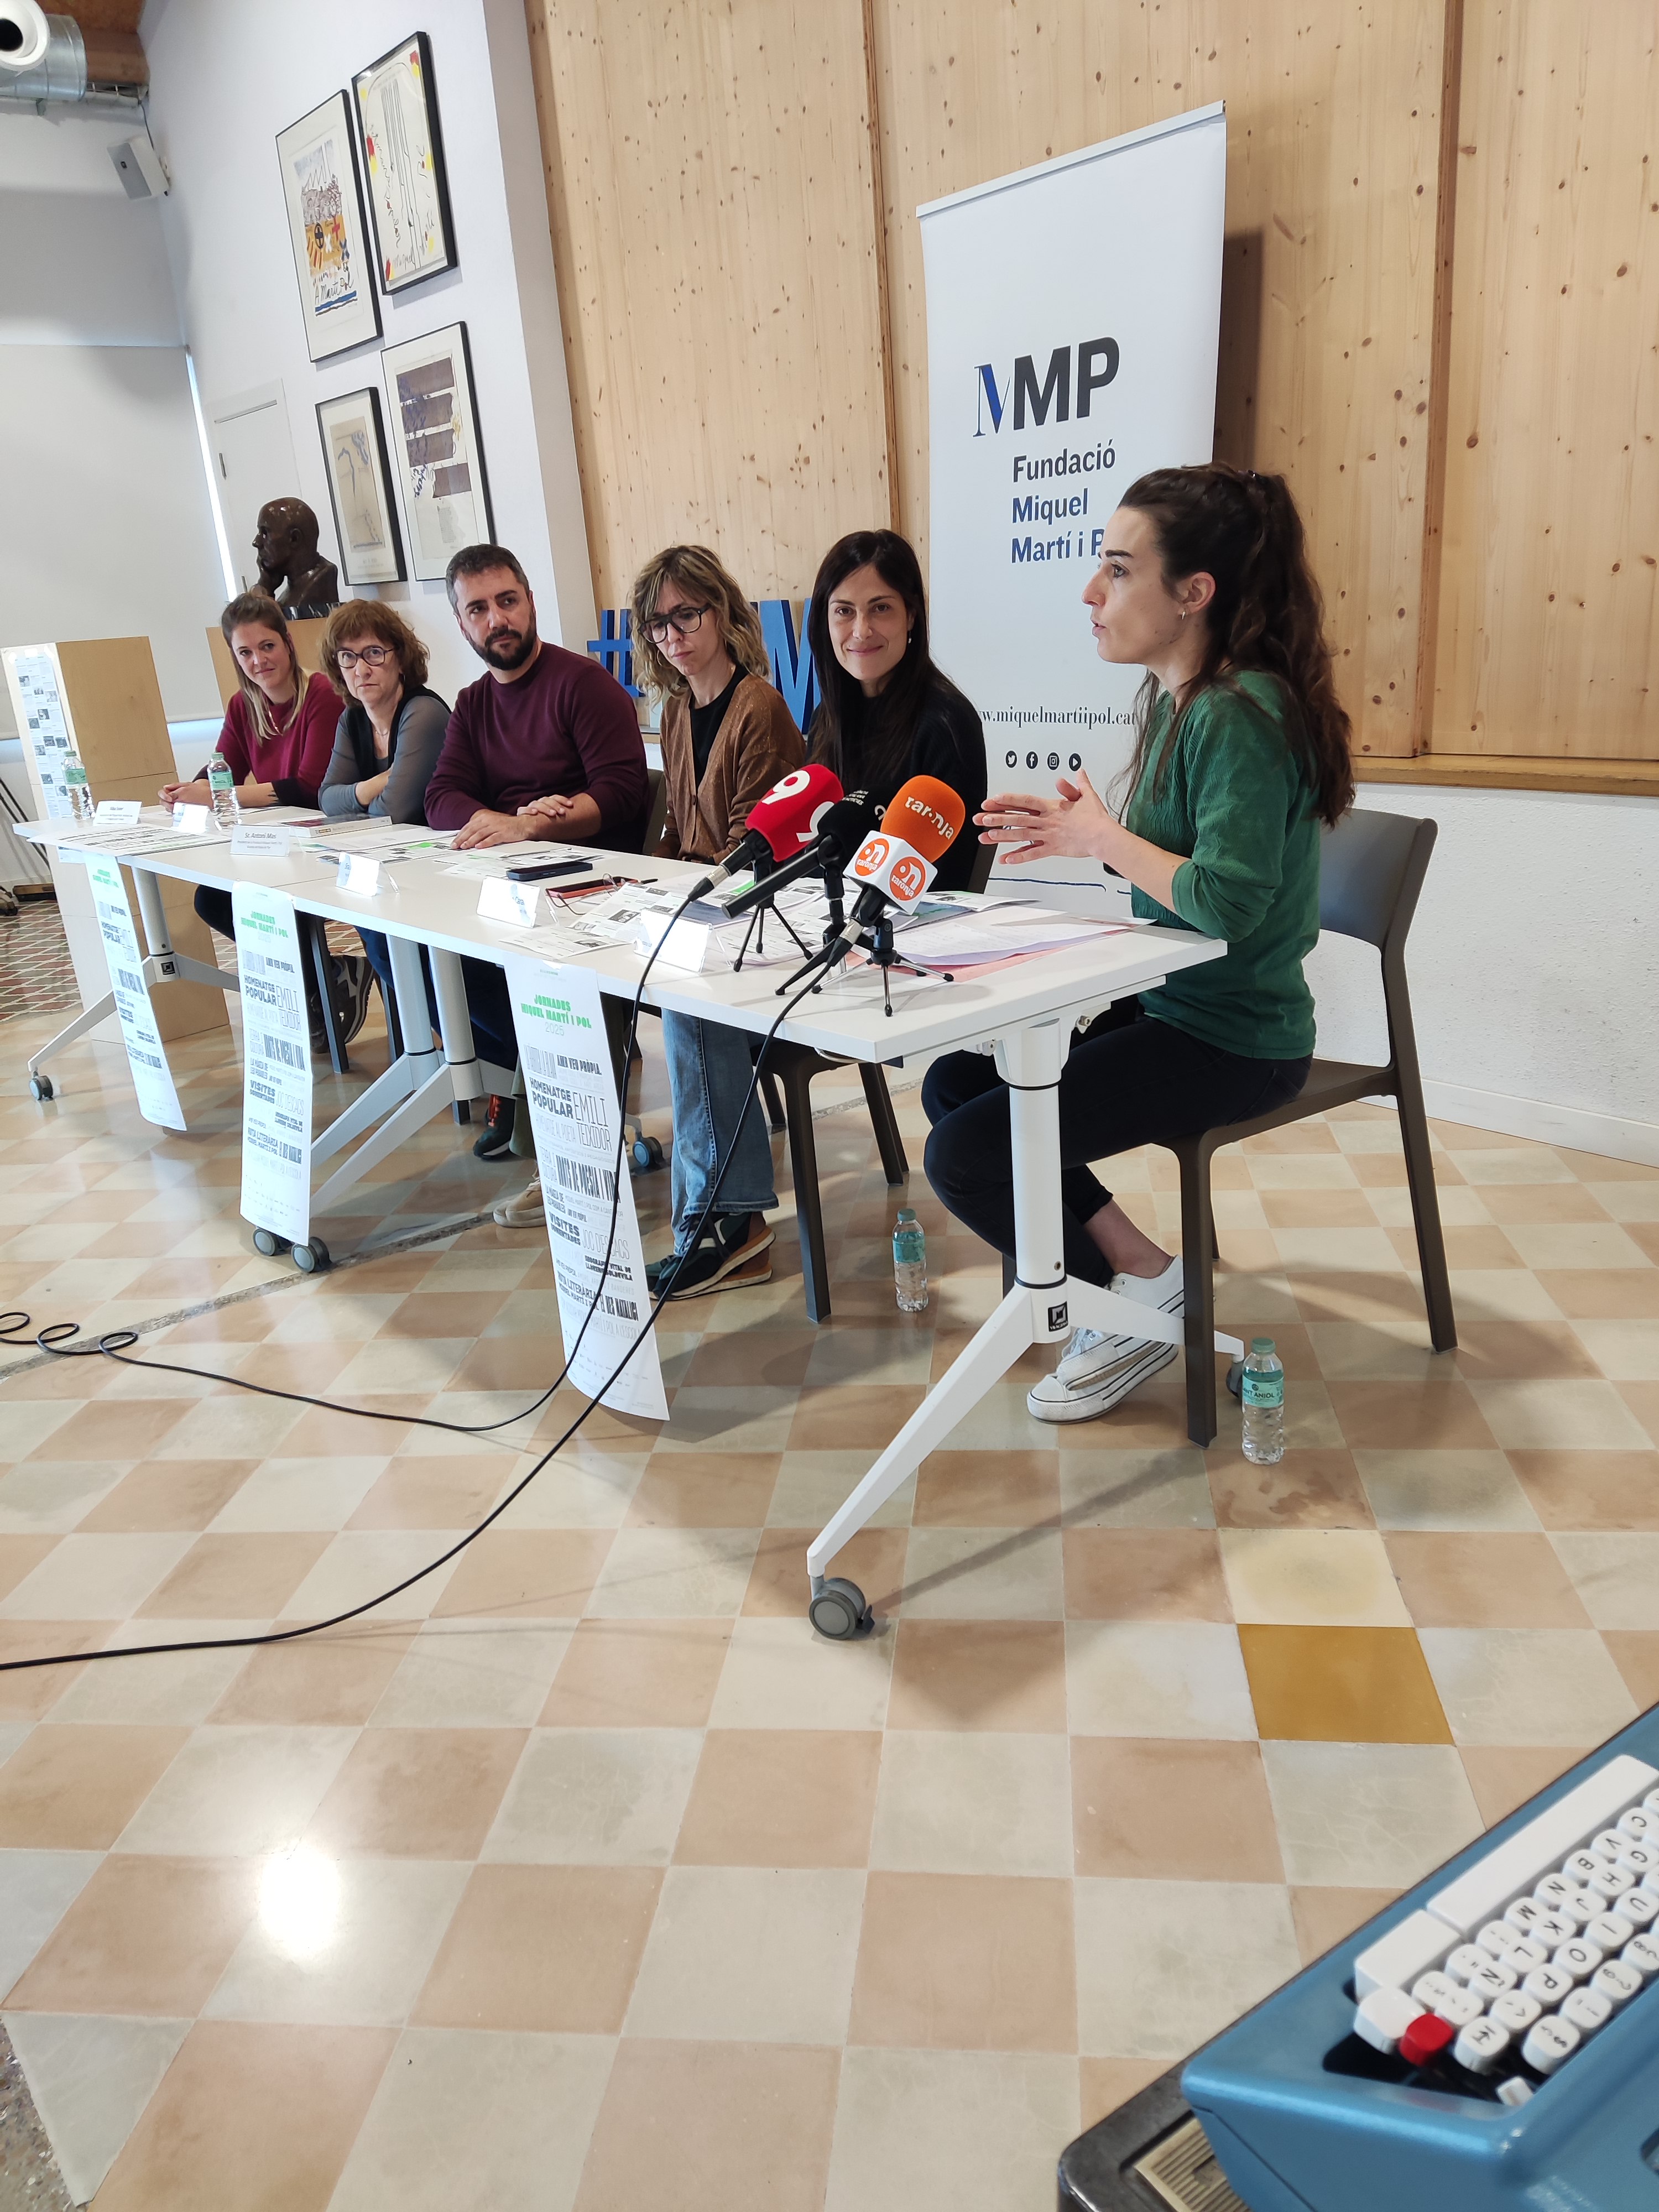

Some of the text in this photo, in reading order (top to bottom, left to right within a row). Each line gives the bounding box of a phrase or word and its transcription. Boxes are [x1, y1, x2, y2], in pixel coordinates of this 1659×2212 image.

[1012, 439, 1116, 483] Fundació
[1011, 488, 1088, 525] Miquel
[1011, 531, 1071, 564] Martí
[1078, 530, 1084, 557] i
[978, 706, 1136, 730] w.miquelmartiipol.cat
[534, 994, 571, 1012] JORNADES
[521, 1003, 592, 1029] MIQUEL MARTÍ I POL
[545, 1021, 565, 1036] 2025
[529, 1077, 571, 1102] HOMENATGE
[531, 1090, 574, 1119] POPULAR
[572, 1092, 608, 1127] EMILI
[576, 1121, 612, 1151] TEIXIDOR
[549, 1211, 580, 1237] VISITES
[582, 1228, 594, 1251] JOC
[1631, 1850, 1647, 1863] G
[1516, 1816, 1647, 1921] C V B N M
[1602, 1872, 1621, 1886] H
[1576, 1897, 1589, 1911] J
[1630, 1897, 1649, 1912] U
[1543, 1920, 1564, 1936] K
[1514, 1945, 1534, 1958] L
[1569, 1948, 1587, 1962] O
[1543, 1973, 1558, 1989] P
